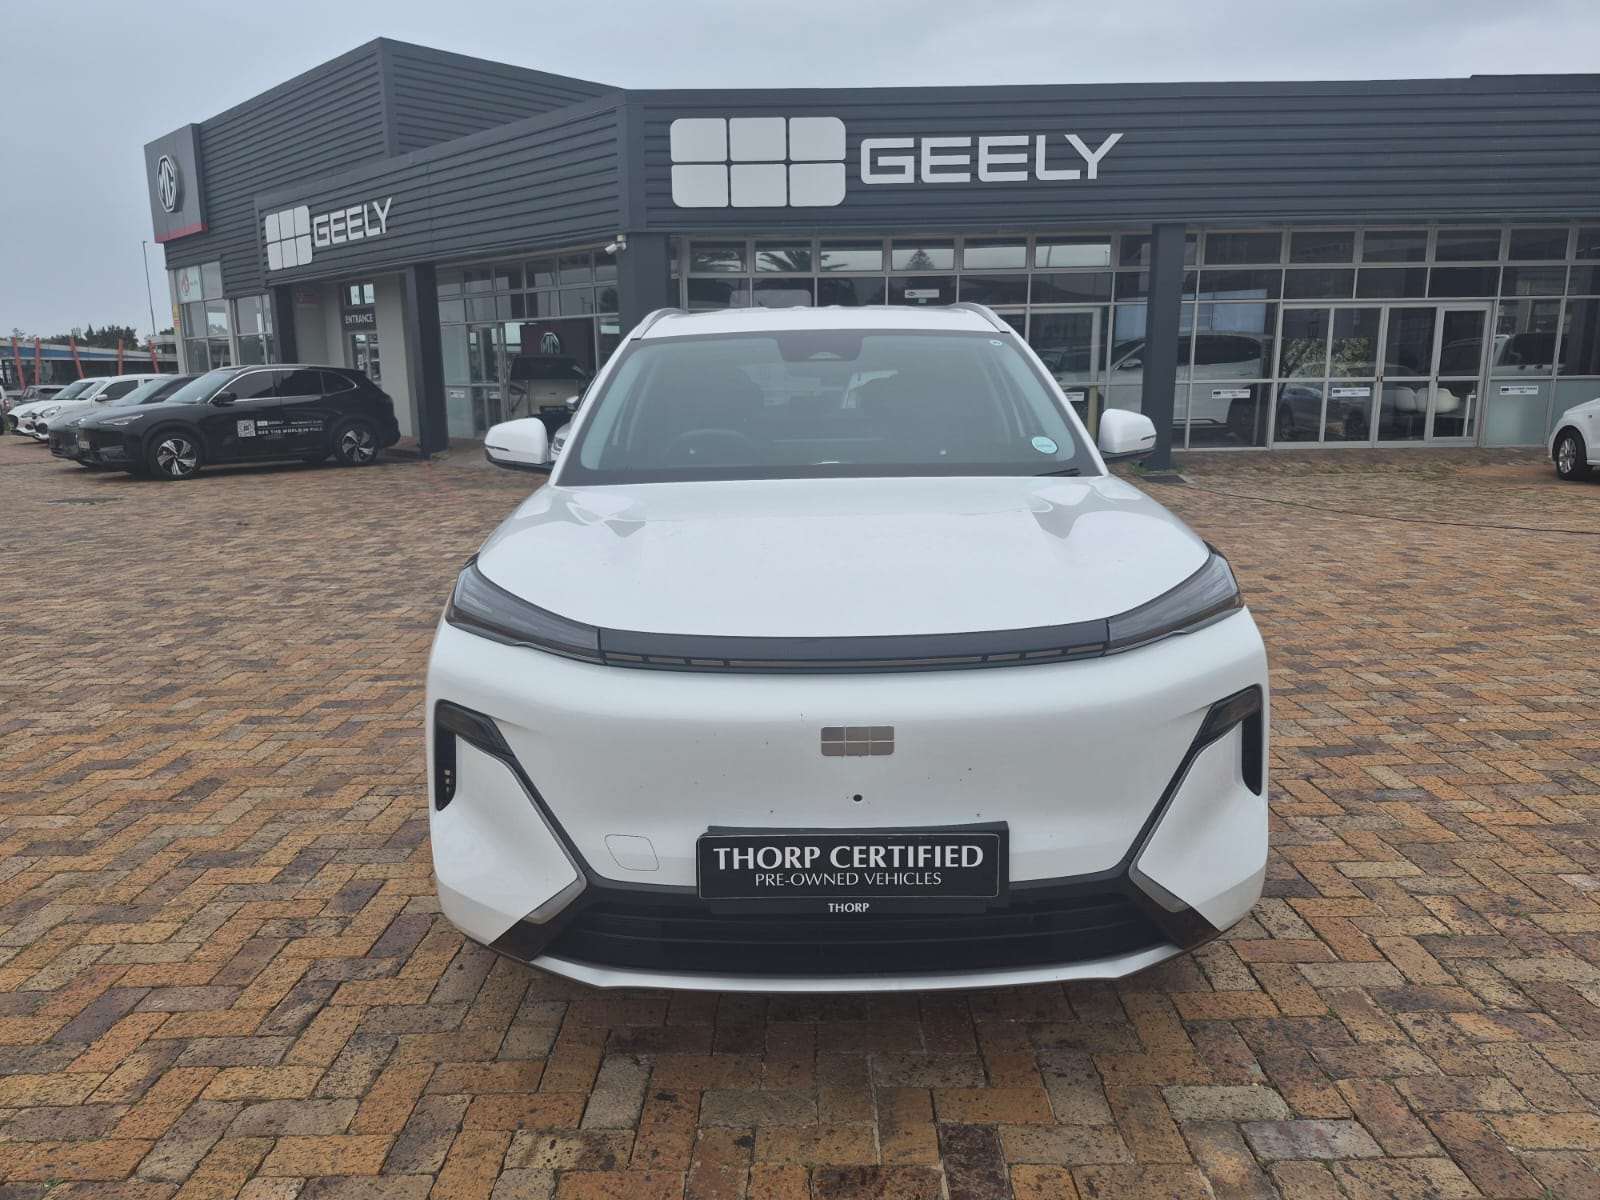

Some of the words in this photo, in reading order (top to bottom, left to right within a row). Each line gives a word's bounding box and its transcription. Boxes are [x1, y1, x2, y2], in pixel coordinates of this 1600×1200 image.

[860, 132, 1124, 185] GEELY
[158, 159, 176, 208] MG
[313, 197, 393, 248] GEELY
[344, 313, 374, 324] ENTRANCE
[713, 846, 821, 870] THORP
[829, 845, 984, 869] CERTIFIED
[755, 872, 859, 887] PRE-OWNED
[864, 871, 942, 886] VEHICLES
[827, 902, 870, 913] THORP
